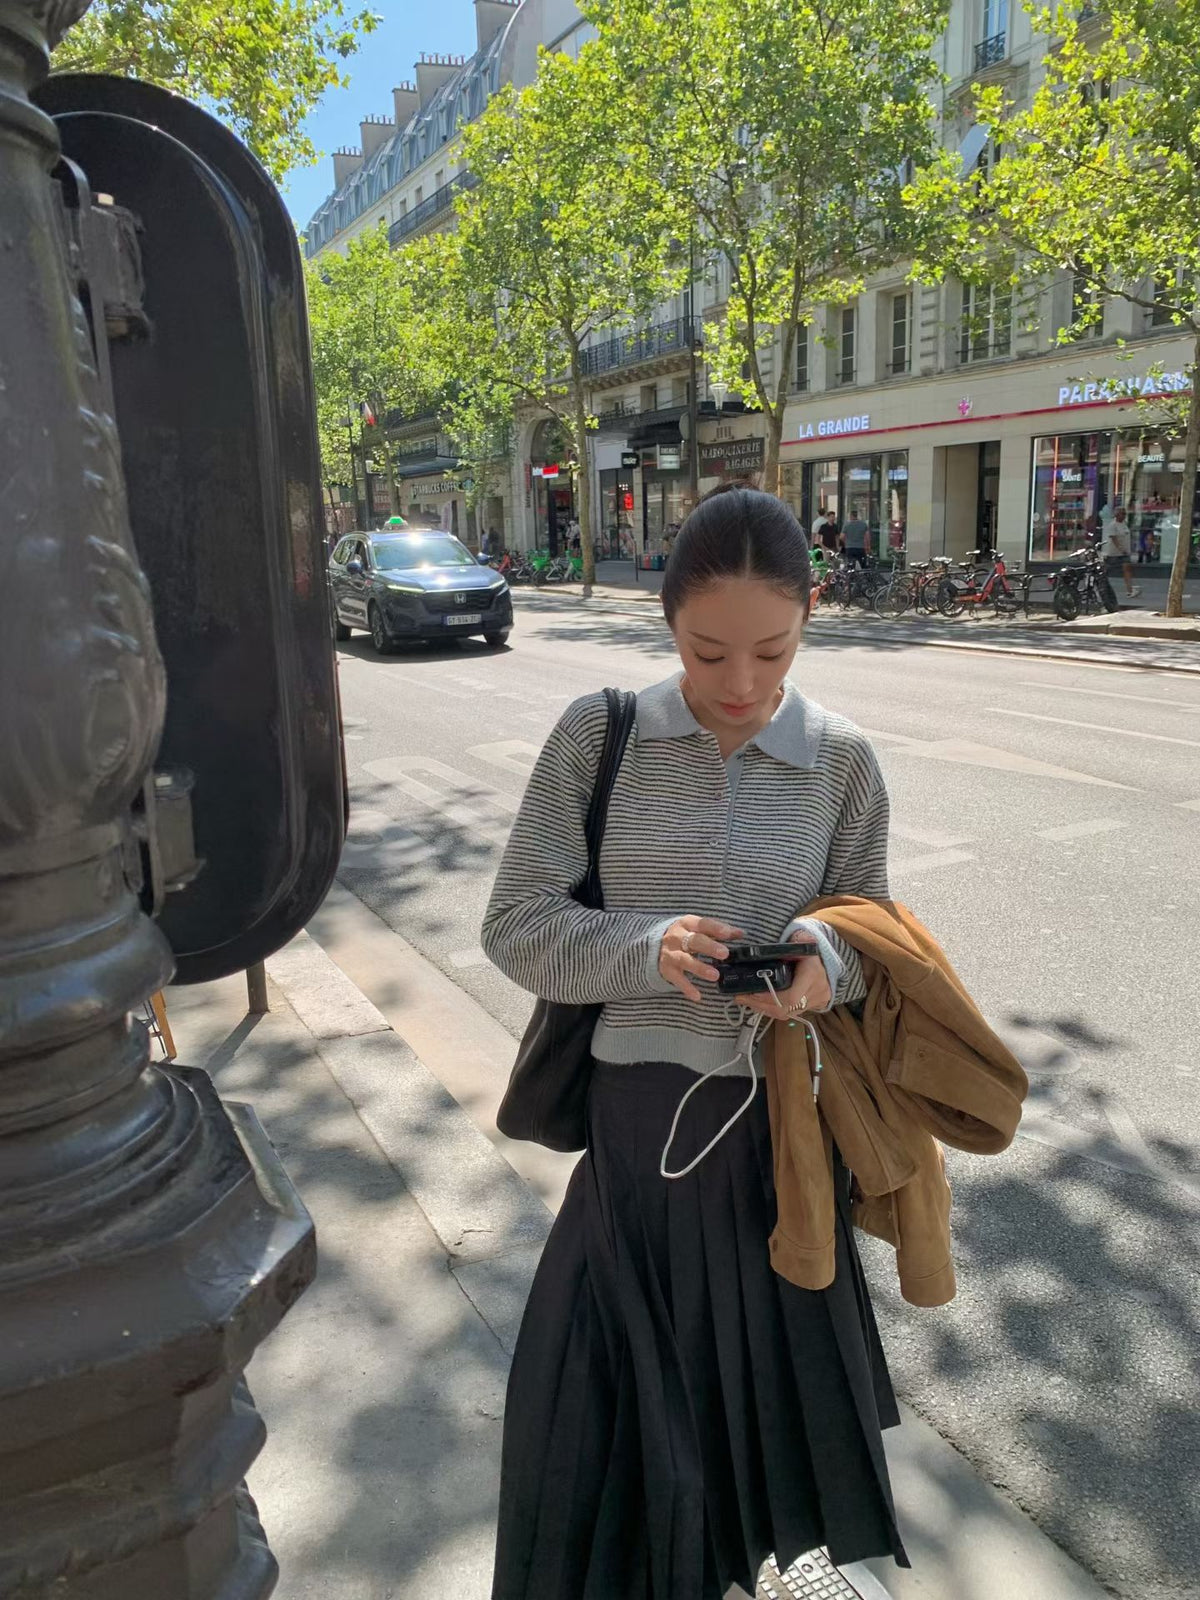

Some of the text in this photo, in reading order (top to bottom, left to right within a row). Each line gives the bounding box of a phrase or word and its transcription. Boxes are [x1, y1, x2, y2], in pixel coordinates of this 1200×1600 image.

[799, 415, 870, 438] LA GRANDE
[412, 482, 441, 496] STARBUCKS
